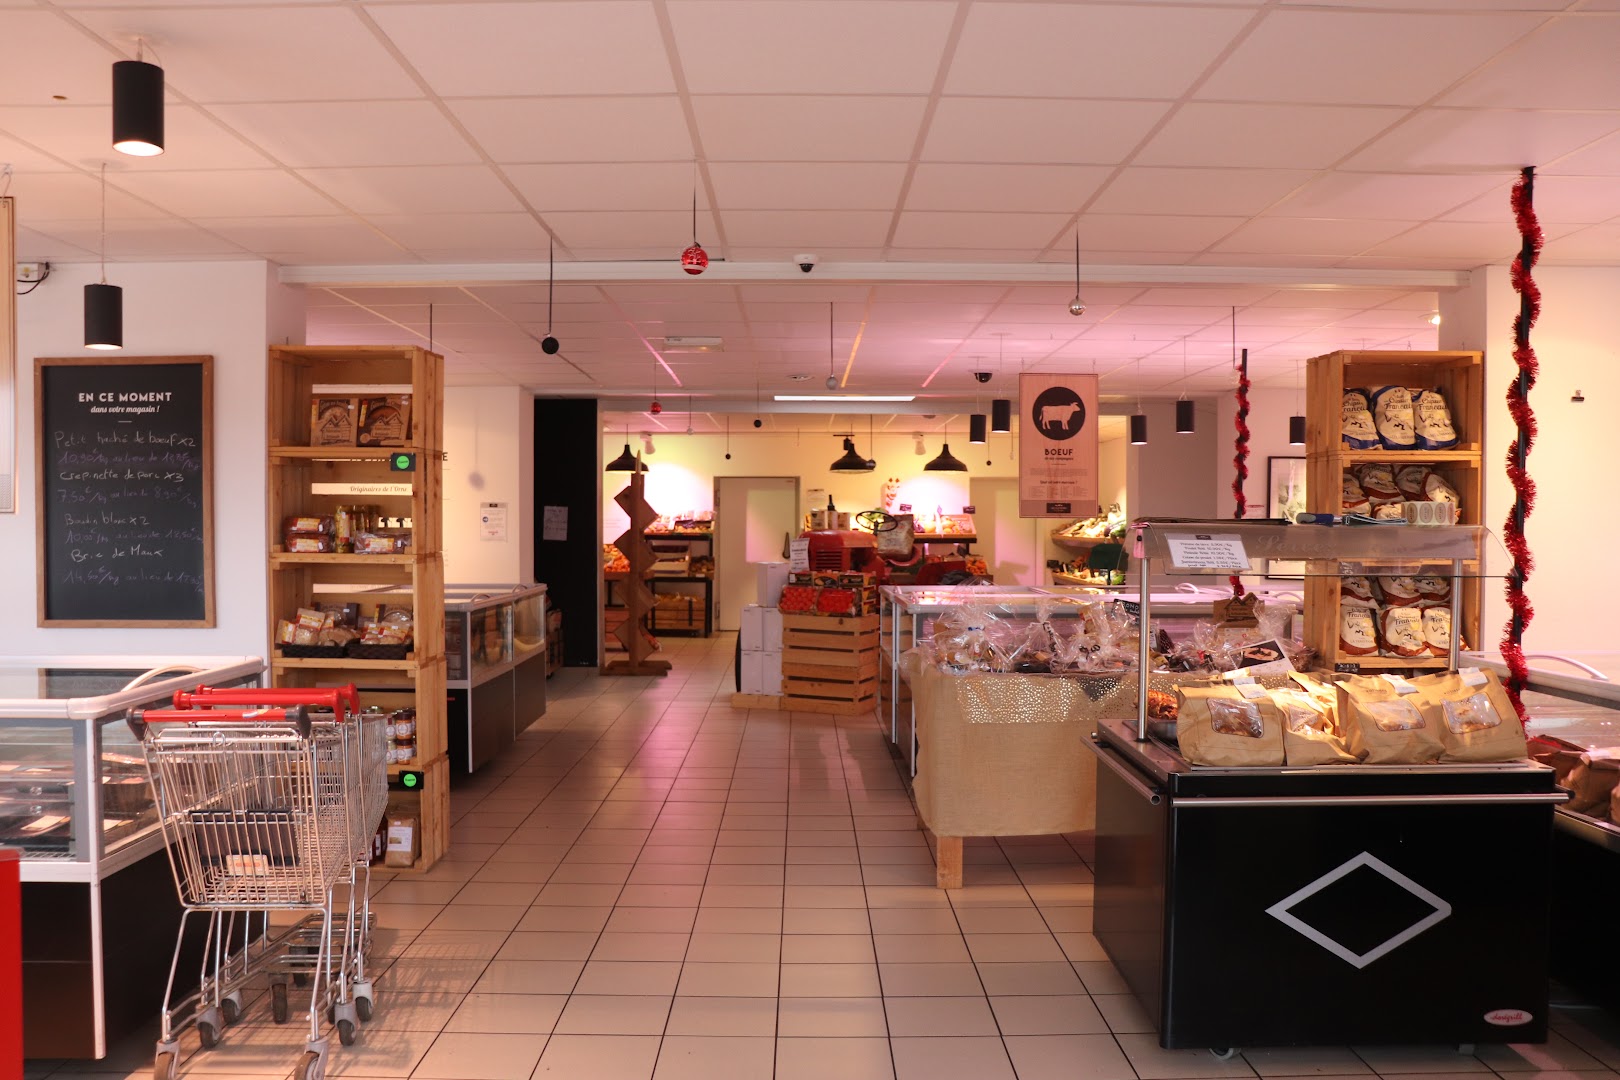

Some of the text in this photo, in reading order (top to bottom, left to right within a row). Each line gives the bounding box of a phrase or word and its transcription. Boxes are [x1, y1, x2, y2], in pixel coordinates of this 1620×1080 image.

[78, 392, 172, 402] EN CE MOMENT
[90, 406, 108, 414] dans
[125, 406, 155, 415] magasin
[54, 431, 87, 448] Petit
[134, 430, 146, 444] de
[124, 468, 134, 480] de
[137, 471, 160, 481] porc
[70, 548, 104, 563] Brie
[112, 547, 125, 559] de
